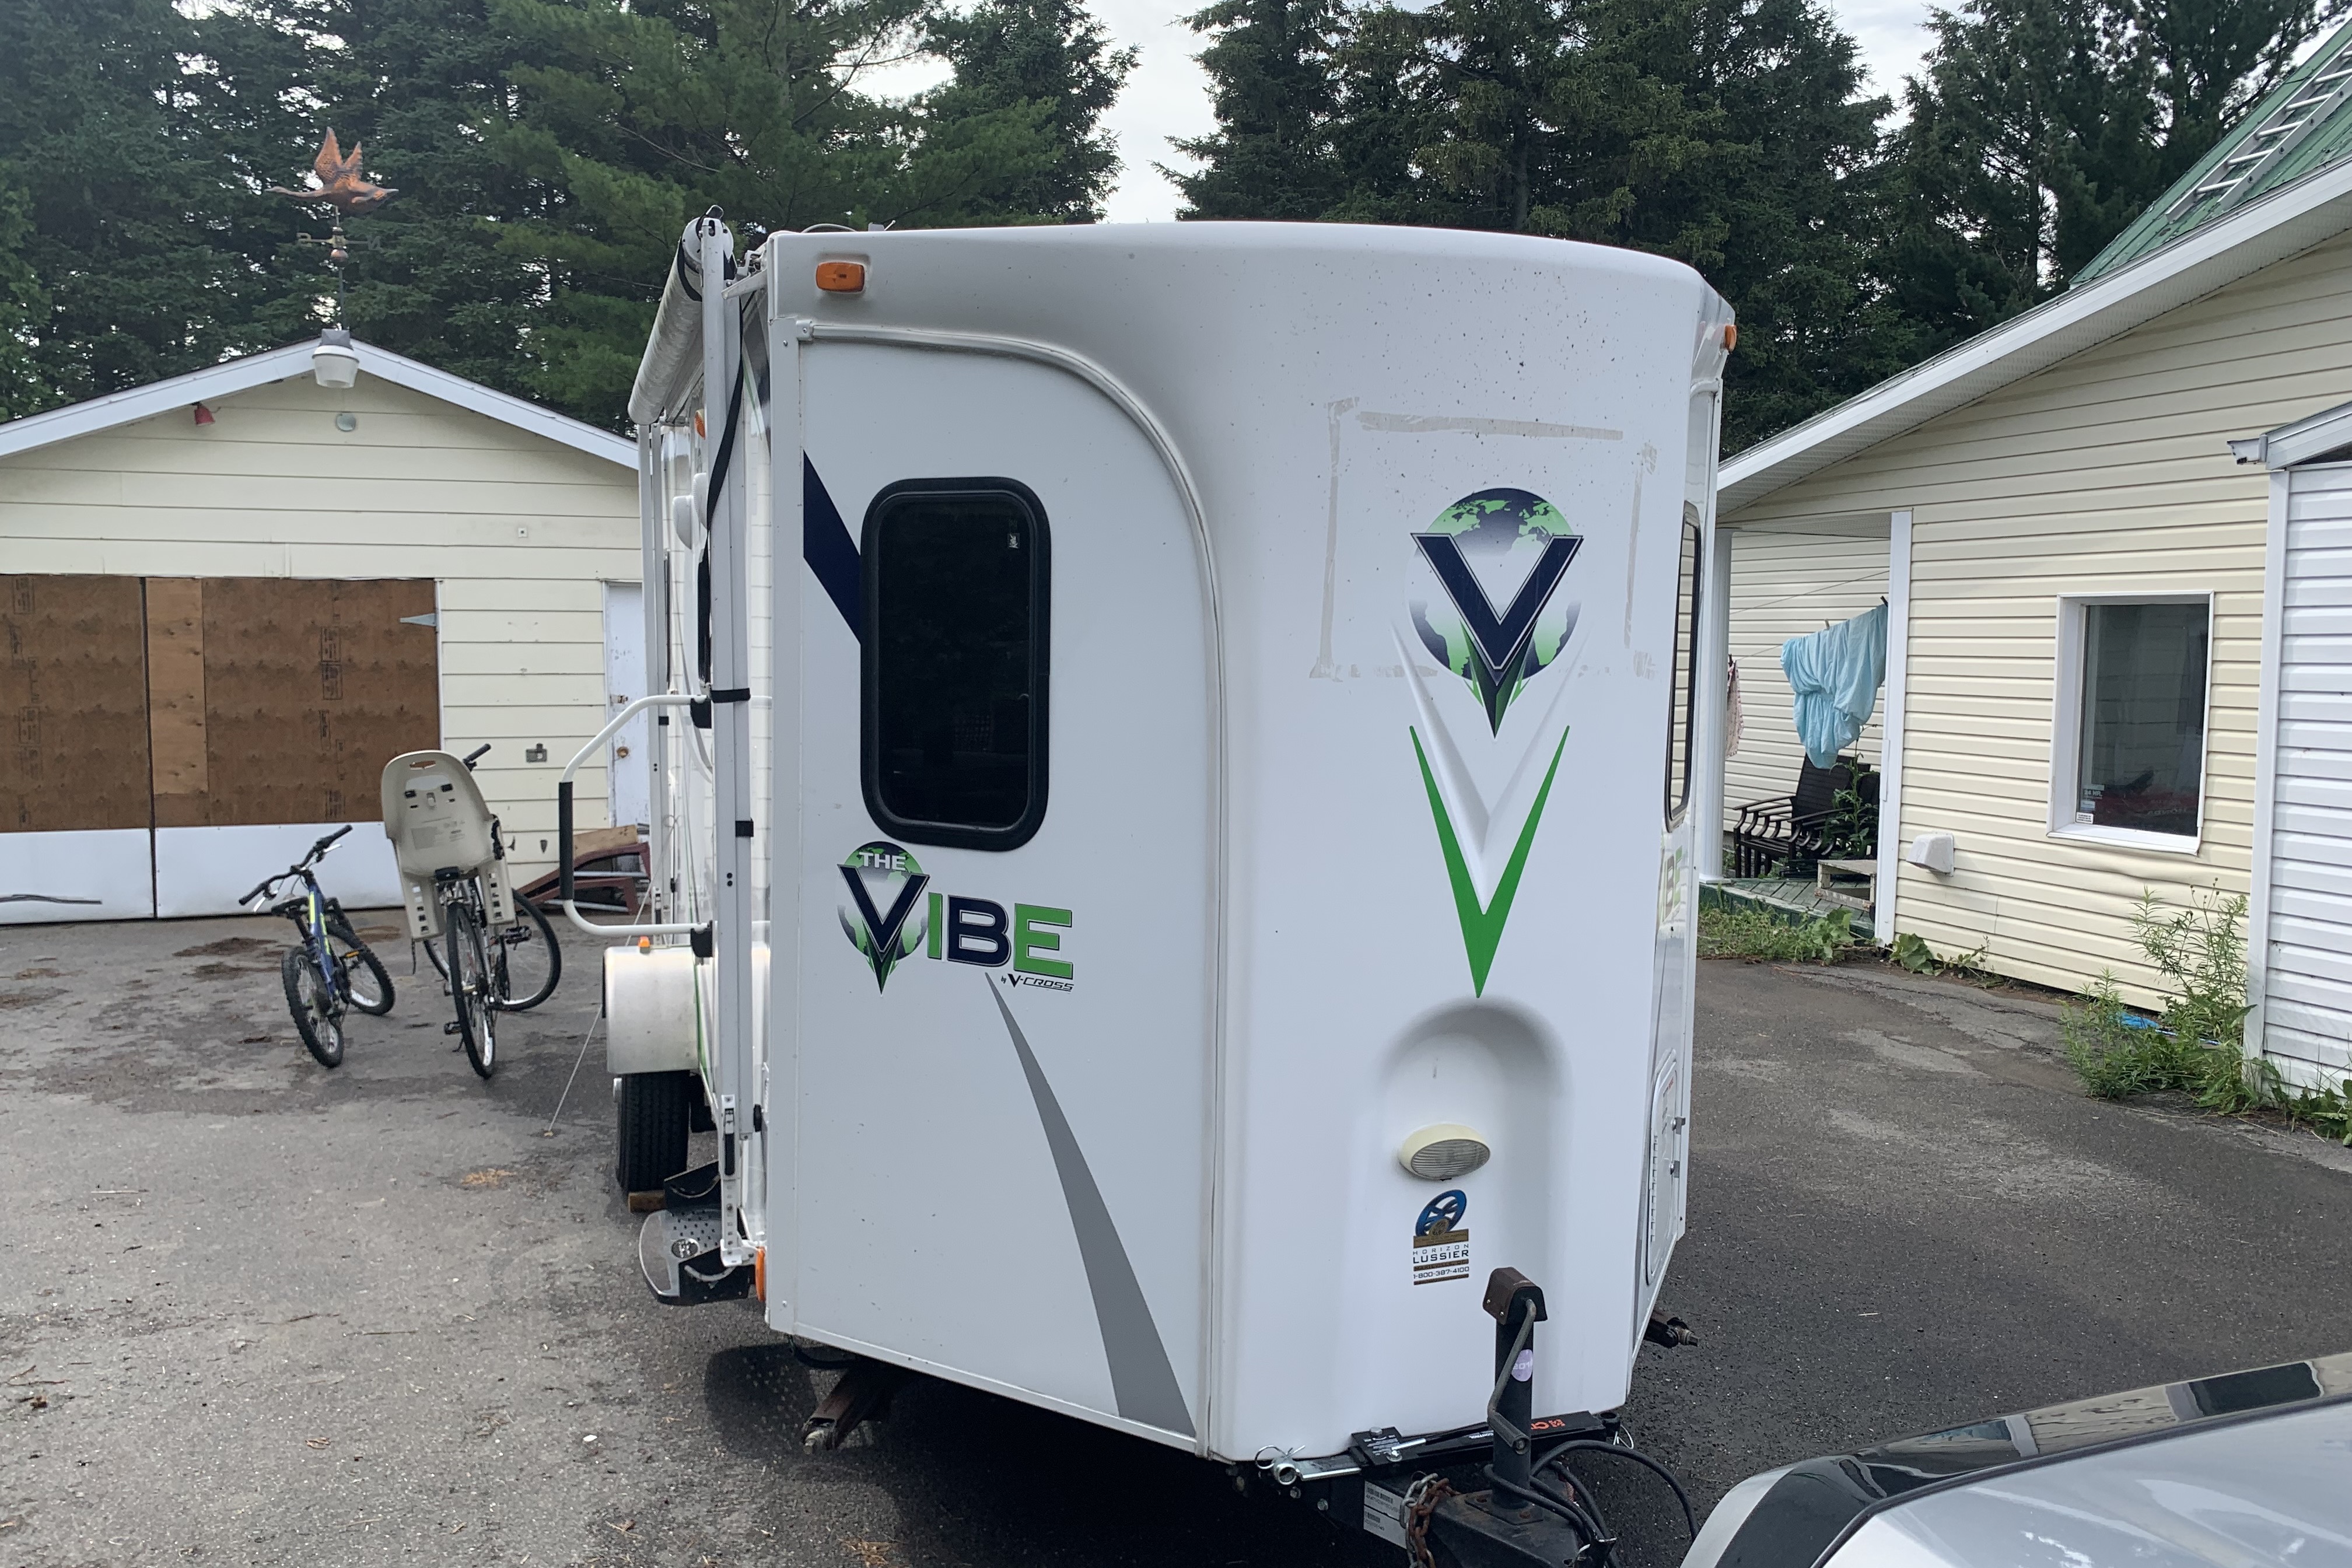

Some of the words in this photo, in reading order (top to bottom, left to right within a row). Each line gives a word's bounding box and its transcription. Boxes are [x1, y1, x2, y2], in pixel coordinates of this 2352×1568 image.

[859, 851, 907, 872] THE
[837, 864, 1074, 980] VIBE
[1007, 974, 1074, 992] V-CROSS
[1413, 1244, 1469, 1255] HORIZON
[1413, 1250, 1469, 1264] LUSSIER
[1413, 1266, 1469, 1279] 1-800-387-4100
